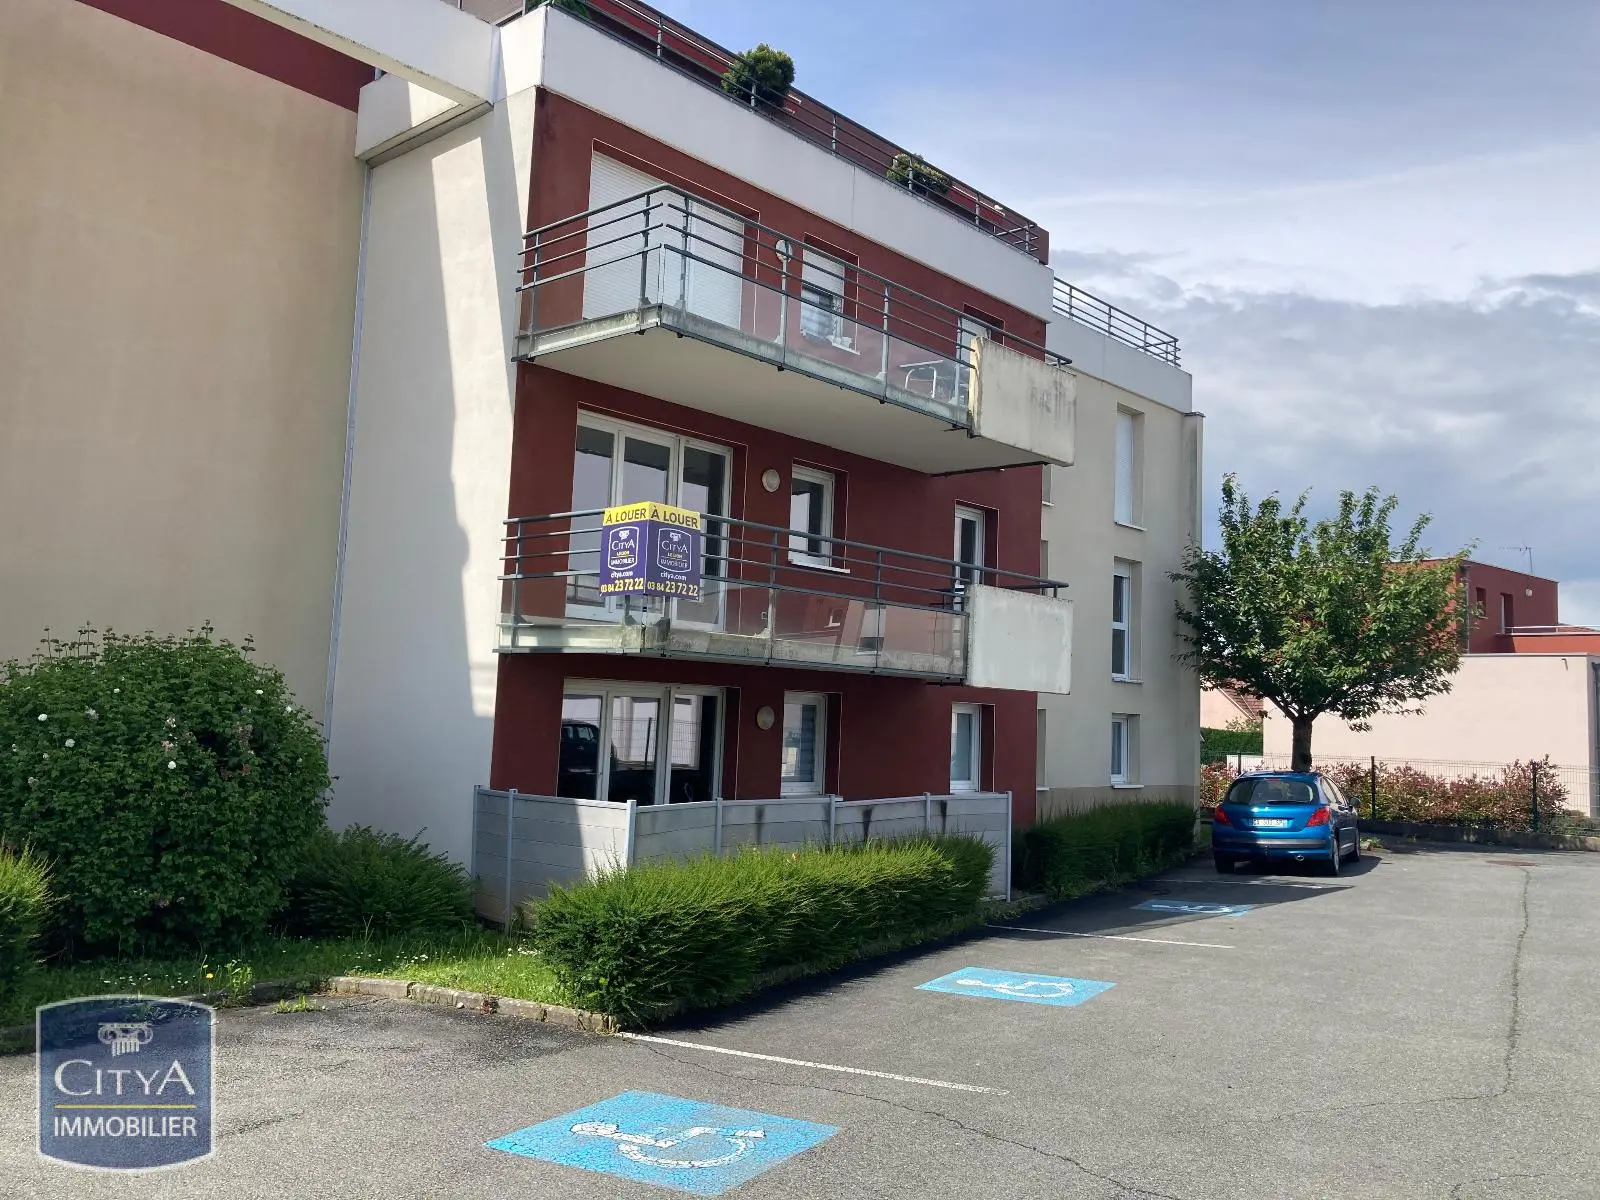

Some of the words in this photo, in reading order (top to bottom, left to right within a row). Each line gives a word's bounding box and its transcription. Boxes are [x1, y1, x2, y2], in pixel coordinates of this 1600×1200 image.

[616, 508, 647, 523] LOUER
[651, 505, 660, 520] À
[664, 511, 698, 528] LOUER
[660, 571, 687, 581] citya.com
[600, 584, 607, 593] 03
[614, 580, 624, 592] 23
[624, 579, 633, 591] 72
[634, 577, 644, 590] 22
[647, 581, 656, 590] 03
[656, 583, 664, 592] 84
[665, 581, 676, 593] 23
[677, 582, 687, 595] 72
[688, 584, 698, 597] 22
